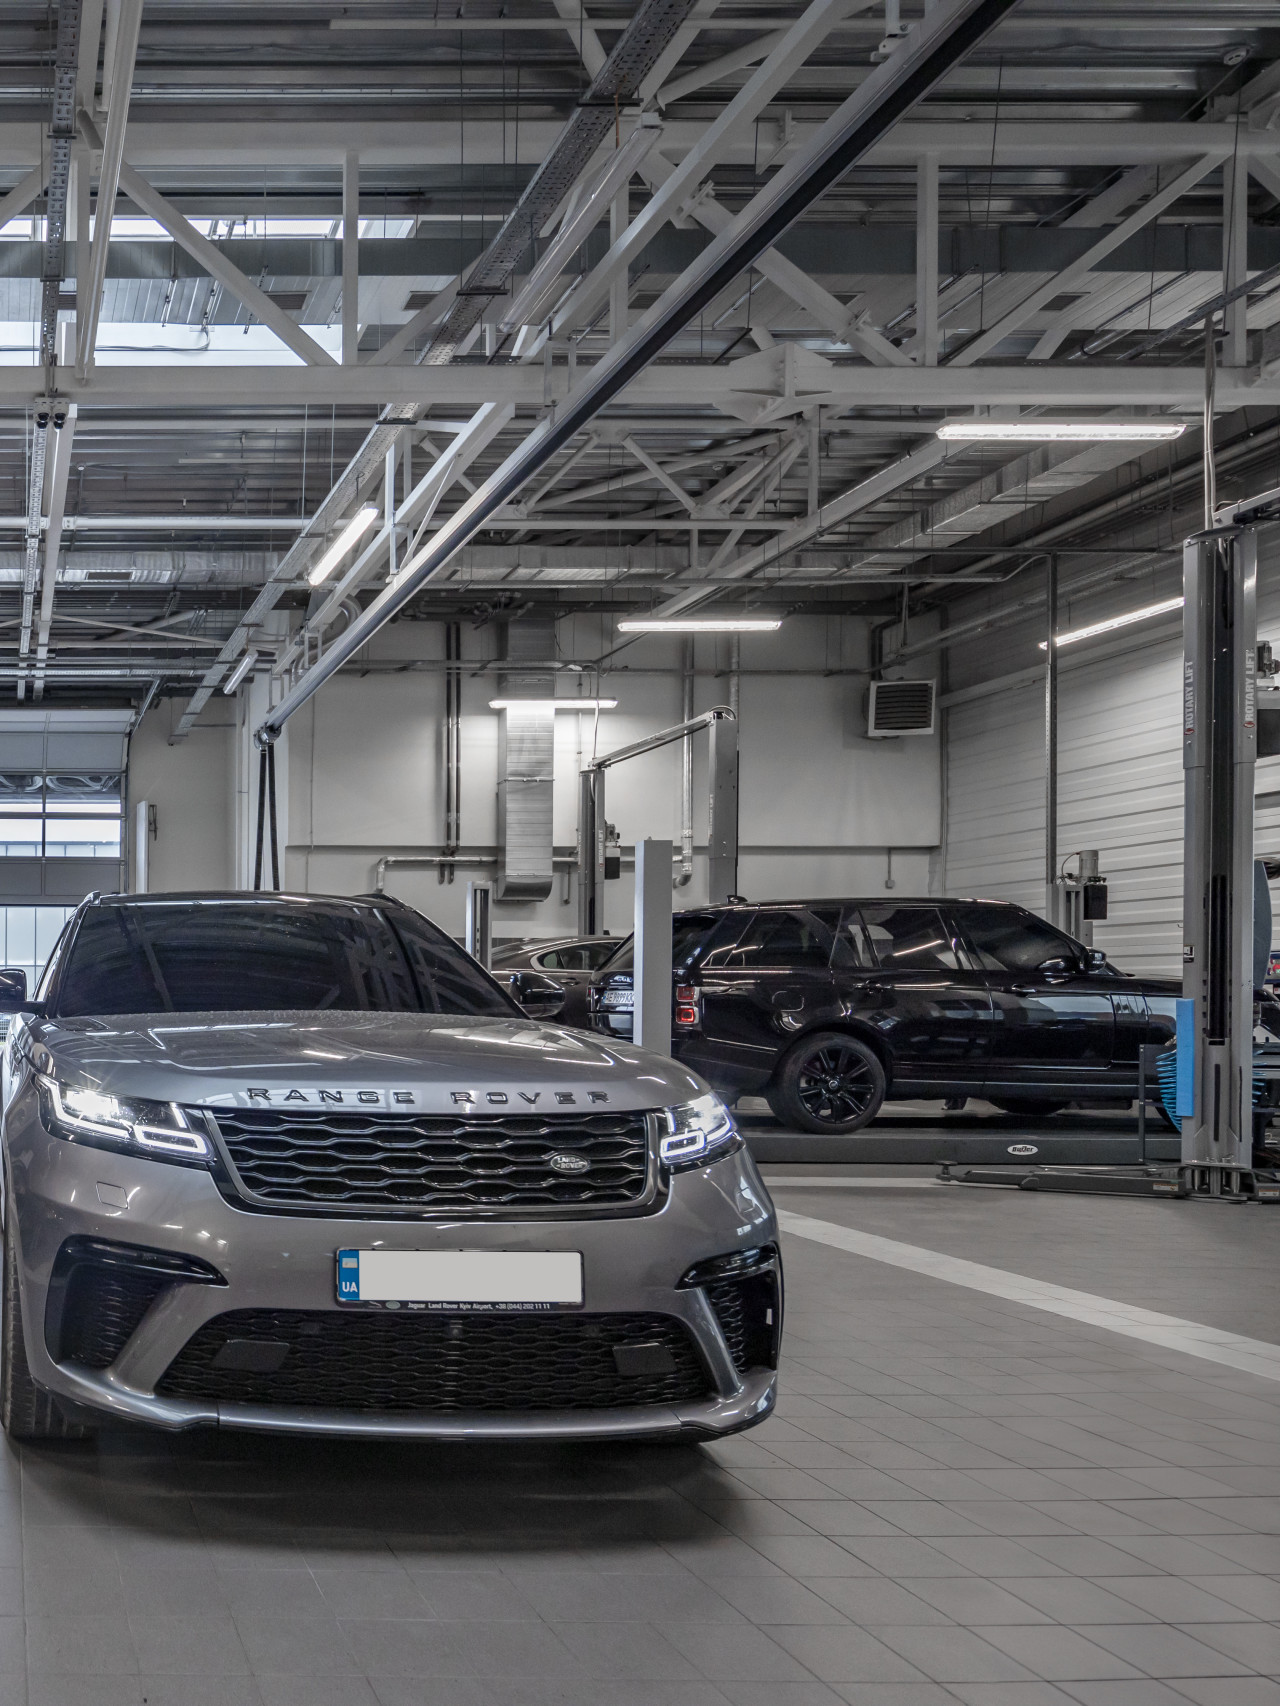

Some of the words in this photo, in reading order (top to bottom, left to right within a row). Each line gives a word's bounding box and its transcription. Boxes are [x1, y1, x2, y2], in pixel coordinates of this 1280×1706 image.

[1185, 661, 1193, 683] LIFT
[1246, 651, 1254, 675] LIFT
[1185, 687, 1194, 728] ROTARY
[1245, 678, 1254, 721] ROTARY
[246, 1087, 416, 1105] RANGE
[450, 1090, 612, 1105] ROVER
[342, 1281, 358, 1292] UA
[408, 1302, 426, 1310] Jaguar
